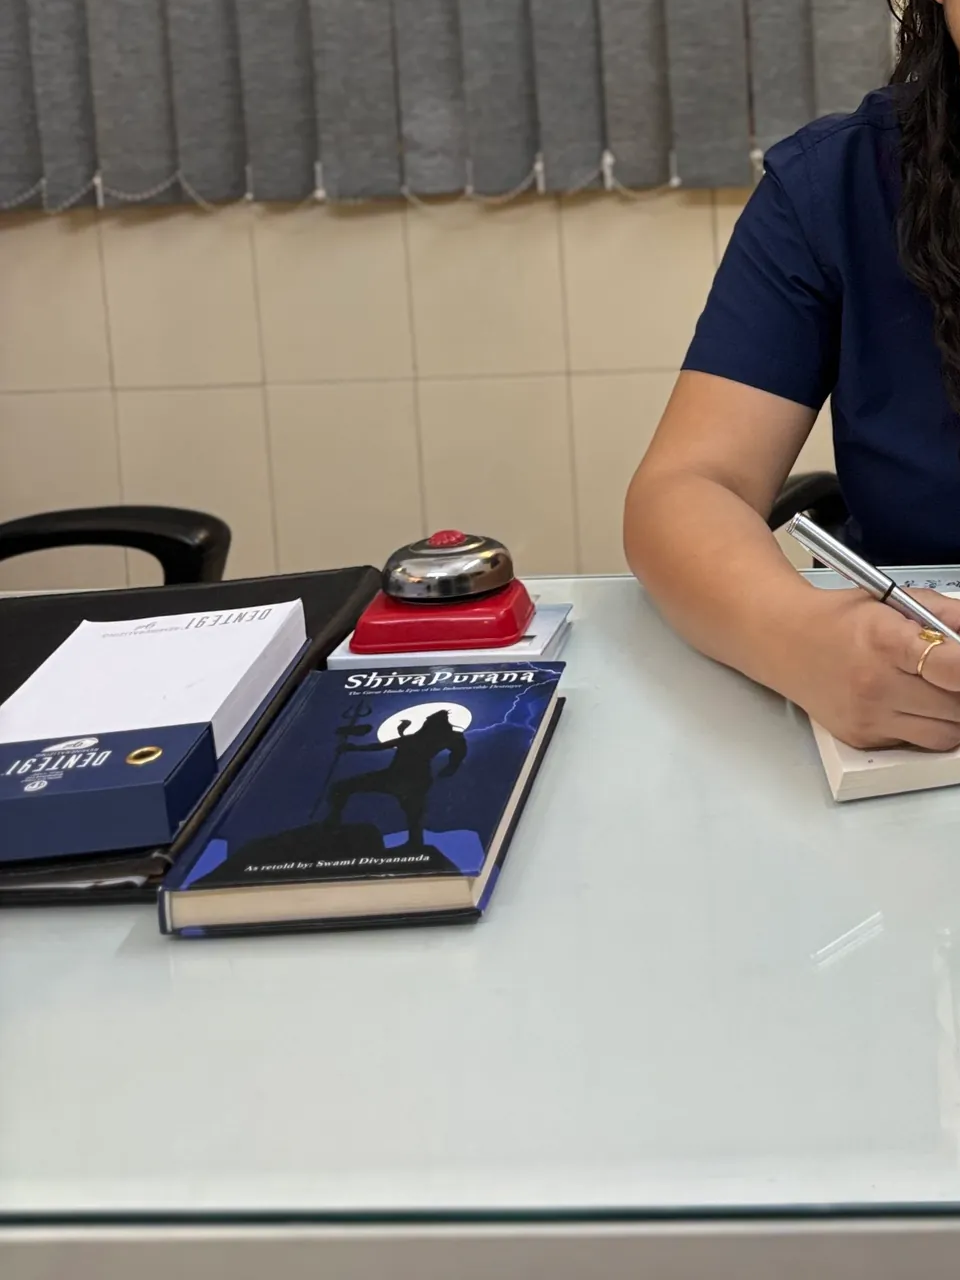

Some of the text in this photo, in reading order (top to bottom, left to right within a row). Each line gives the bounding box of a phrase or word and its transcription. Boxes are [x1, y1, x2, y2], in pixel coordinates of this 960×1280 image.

[185, 608, 272, 630] DENTE91
[344, 671, 535, 689] Shiva Purana
[5, 750, 113, 776] DENTE91
[261, 862, 294, 871] retold
[297, 861, 313, 870] by:
[315, 859, 357, 868] Swami
[358, 854, 430, 866] Divyananda
